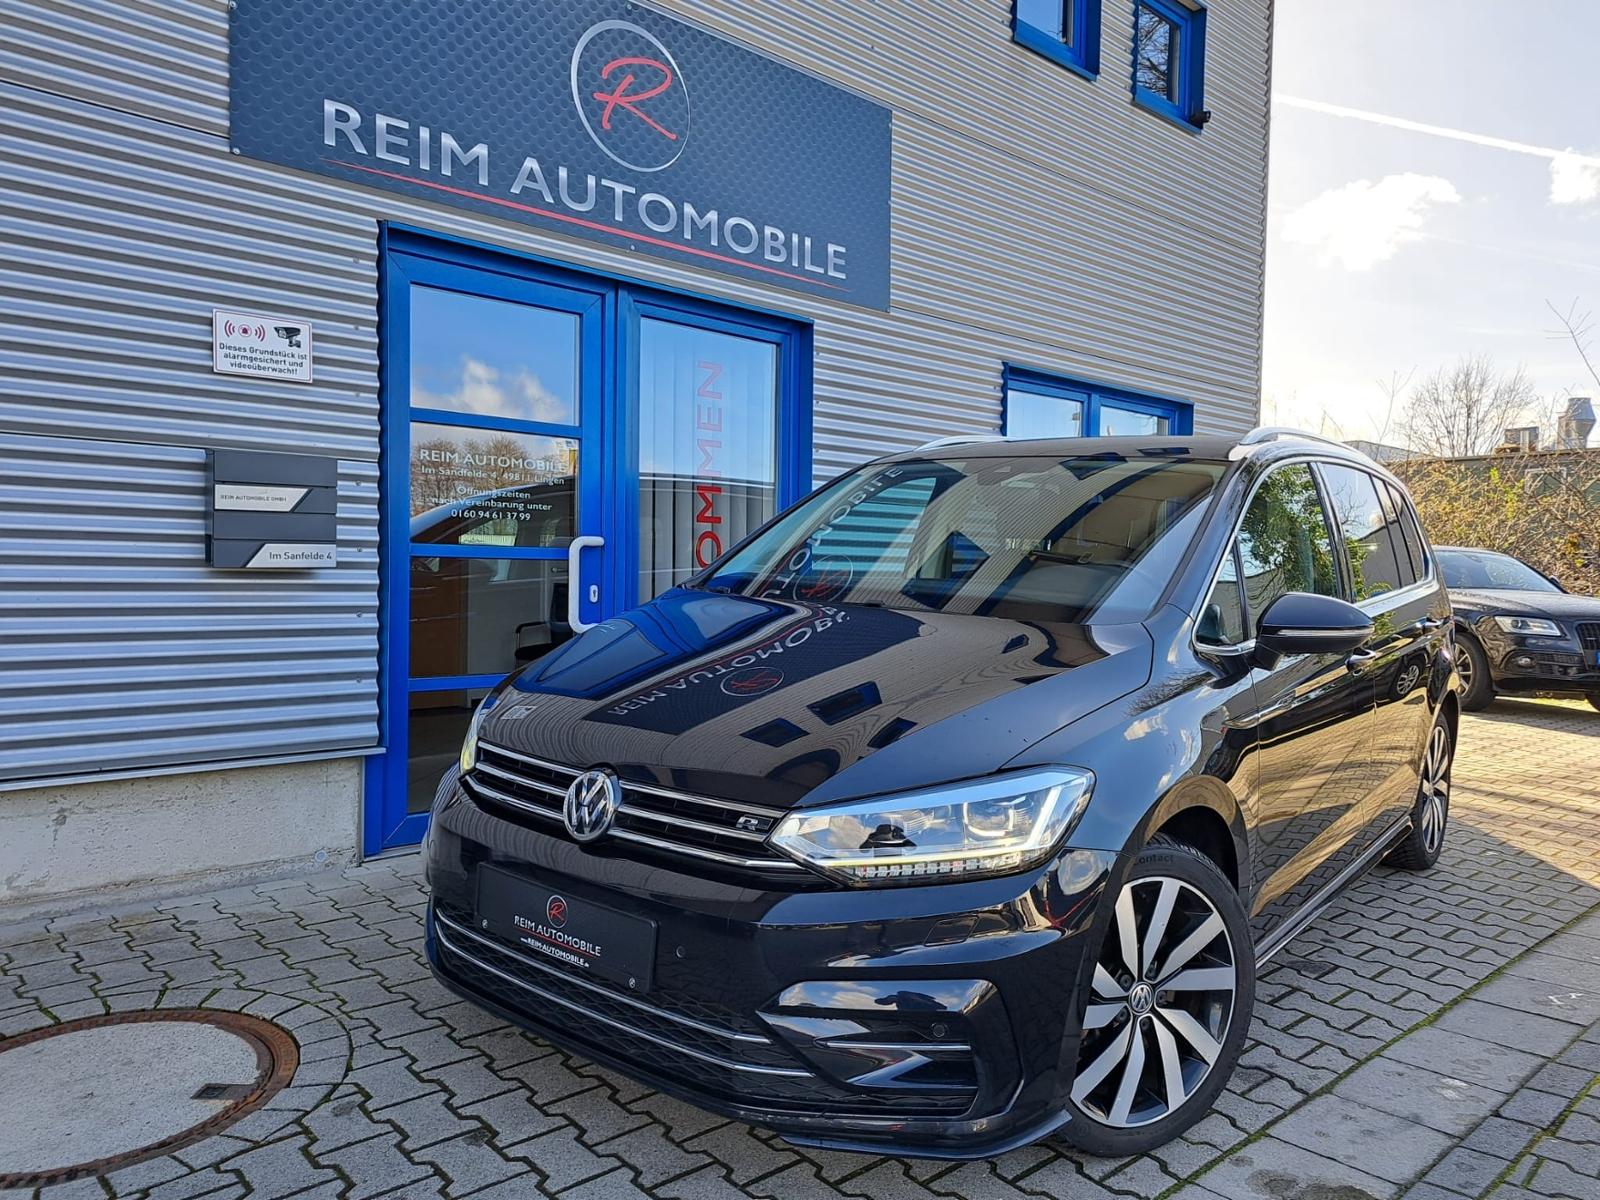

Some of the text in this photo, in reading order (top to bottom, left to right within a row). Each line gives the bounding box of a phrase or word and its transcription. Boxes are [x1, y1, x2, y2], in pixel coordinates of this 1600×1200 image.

[593, 57, 678, 140] R
[323, 98, 848, 280] REIM AUTOMOBILE
[219, 343, 247, 352] Dieses
[249, 346, 296, 359] Grundstück
[223, 352, 304, 368] alarmgesichert und
[229, 361, 298, 375] videoüberwacht!
[420, 449, 567, 473] REIM AUTOMOBILE
[421, 465, 435, 474] Im
[438, 466, 488, 478] Sandfelde
[456, 484, 531, 499] Öffnungszeiten
[458, 497, 525, 511] Vereinbarung
[527, 503, 553, 511] unter
[269, 551, 282, 560] Im
[326, 551, 332, 560] 4
[514, 915, 602, 957] REIM AUTOMOBILE
